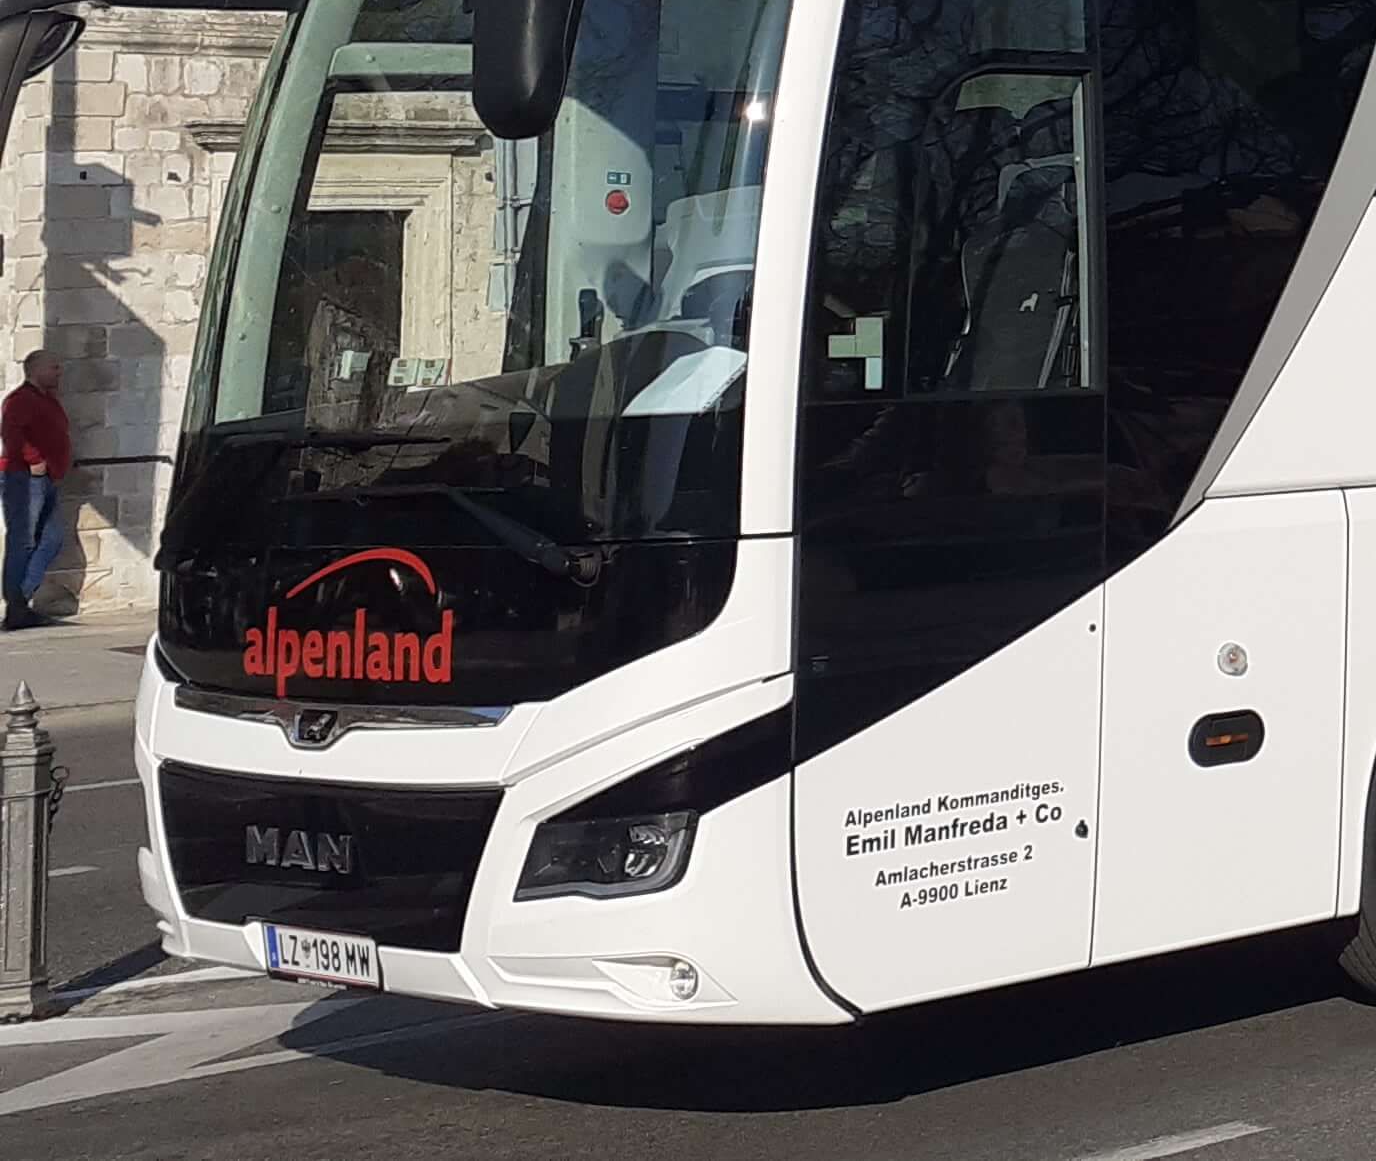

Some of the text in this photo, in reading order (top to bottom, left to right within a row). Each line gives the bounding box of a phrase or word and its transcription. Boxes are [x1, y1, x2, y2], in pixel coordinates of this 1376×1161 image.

[243, 606, 454, 698] alpenland
[845, 781, 1065, 827] Alpenland Kommanditges.
[246, 825, 352, 874] MAN
[846, 803, 1063, 857] Emil Manfreda + Co
[875, 844, 1034, 887] Amlacherstrasse 2
[899, 876, 1008, 909] A-9900 Lienz
[279, 933, 370, 977] LZ 198 MW
